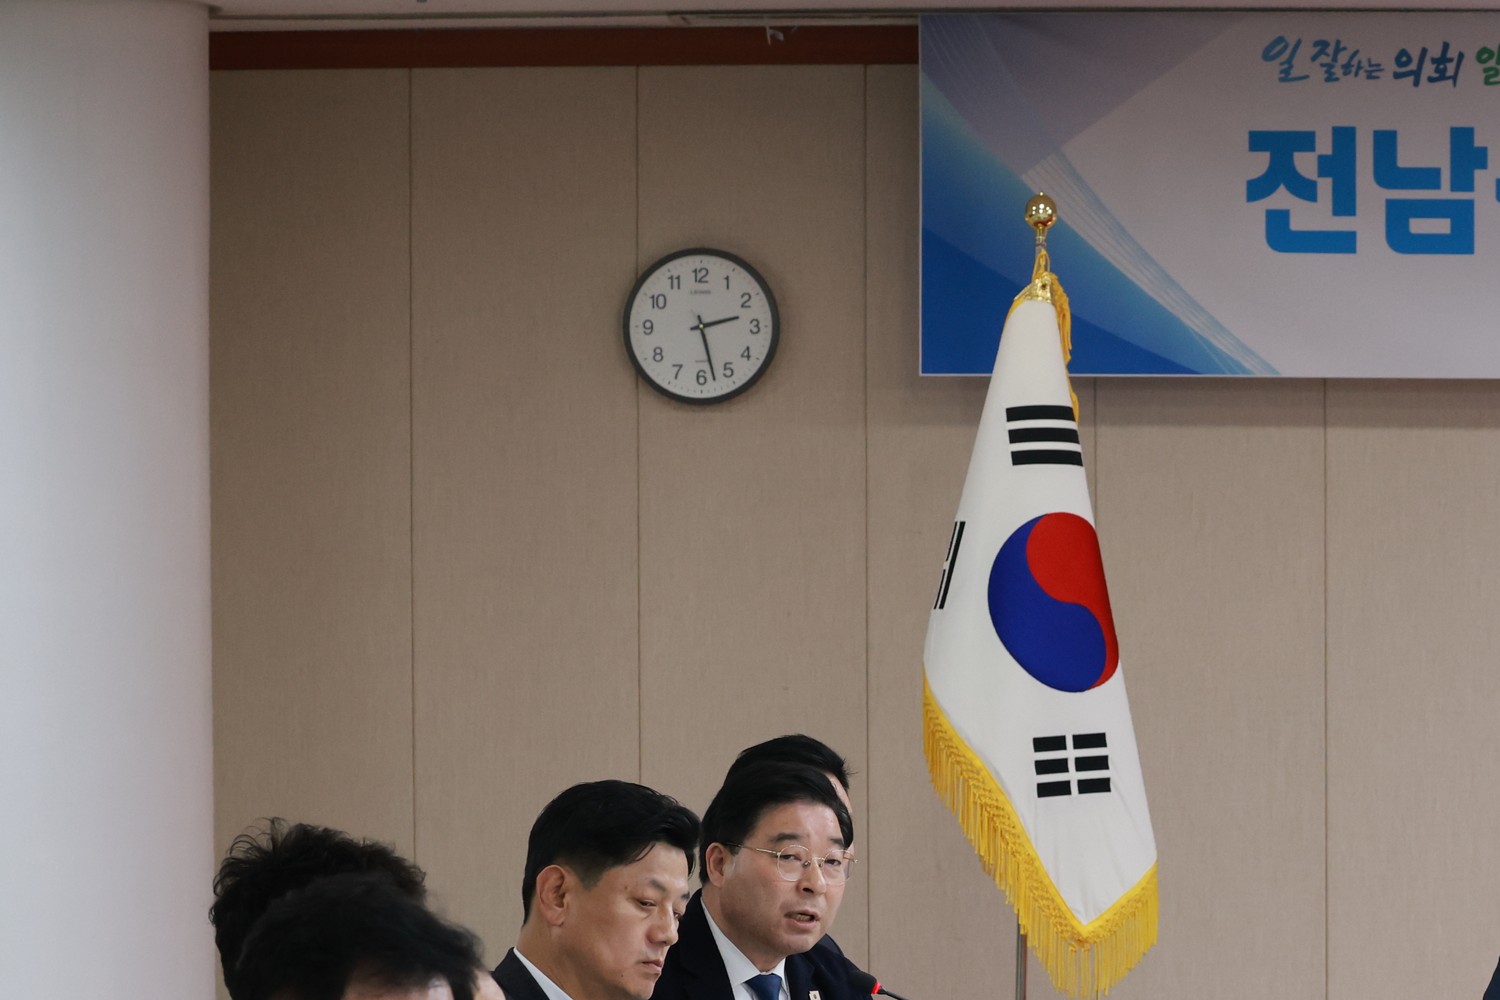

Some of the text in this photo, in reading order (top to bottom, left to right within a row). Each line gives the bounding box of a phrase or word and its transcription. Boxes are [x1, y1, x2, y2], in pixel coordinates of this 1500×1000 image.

[1392, 41, 1465, 88] 의회
[667, 274, 681, 291] 11
[691, 267, 709, 284] 12
[723, 275, 730, 291] 1
[649, 293, 667, 310] 10
[740, 292, 752, 309] 2
[642, 319, 654, 336] 9
[749, 318, 761, 335] 3
[652, 346, 664, 363] 8
[740, 345, 752, 361] 4
[672, 363, 684, 380] 7
[696, 369, 708, 386] 6
[723, 362, 735, 378] 5
